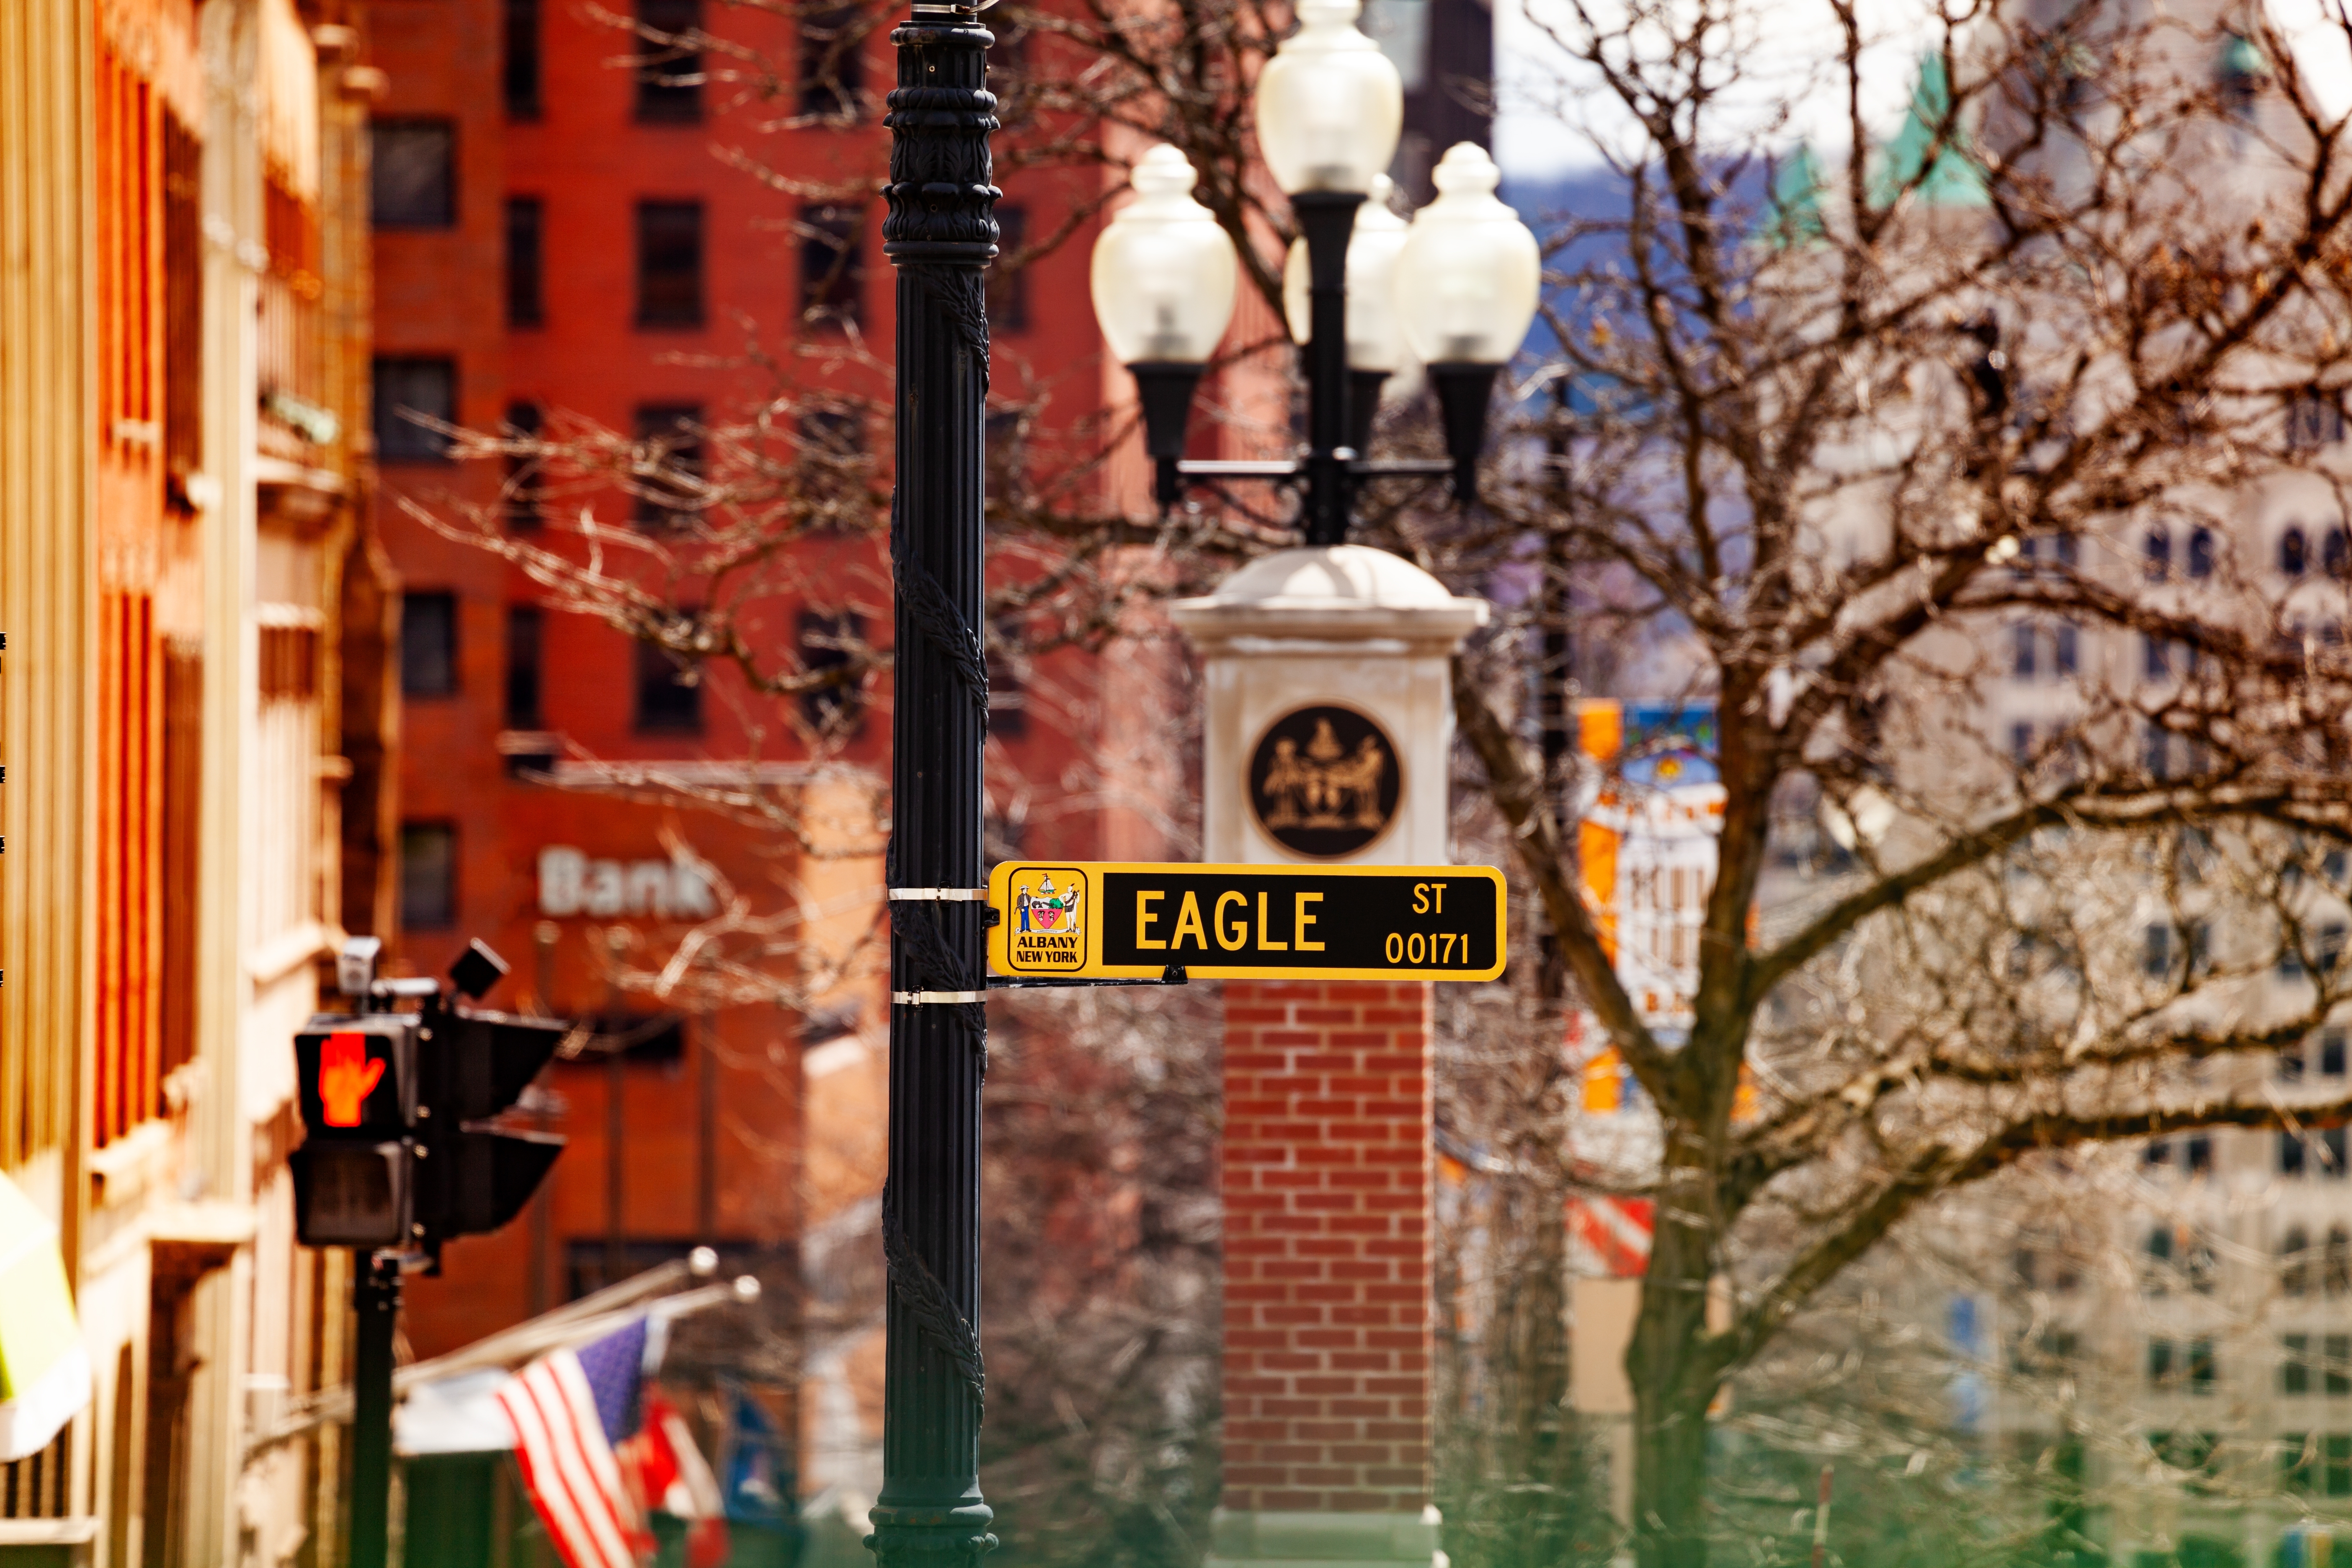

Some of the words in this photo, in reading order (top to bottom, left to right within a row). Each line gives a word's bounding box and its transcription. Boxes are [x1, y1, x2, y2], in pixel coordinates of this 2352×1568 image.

[539, 845, 716, 918] Bank
[1136, 890, 1325, 951] EAGLE
[1412, 883, 1447, 914] ST
[1016, 951, 1043, 962] NEW
[1045, 951, 1078, 963] YORK
[1017, 936, 1078, 948] ALBANY
[1385, 933, 1468, 964] 00171
